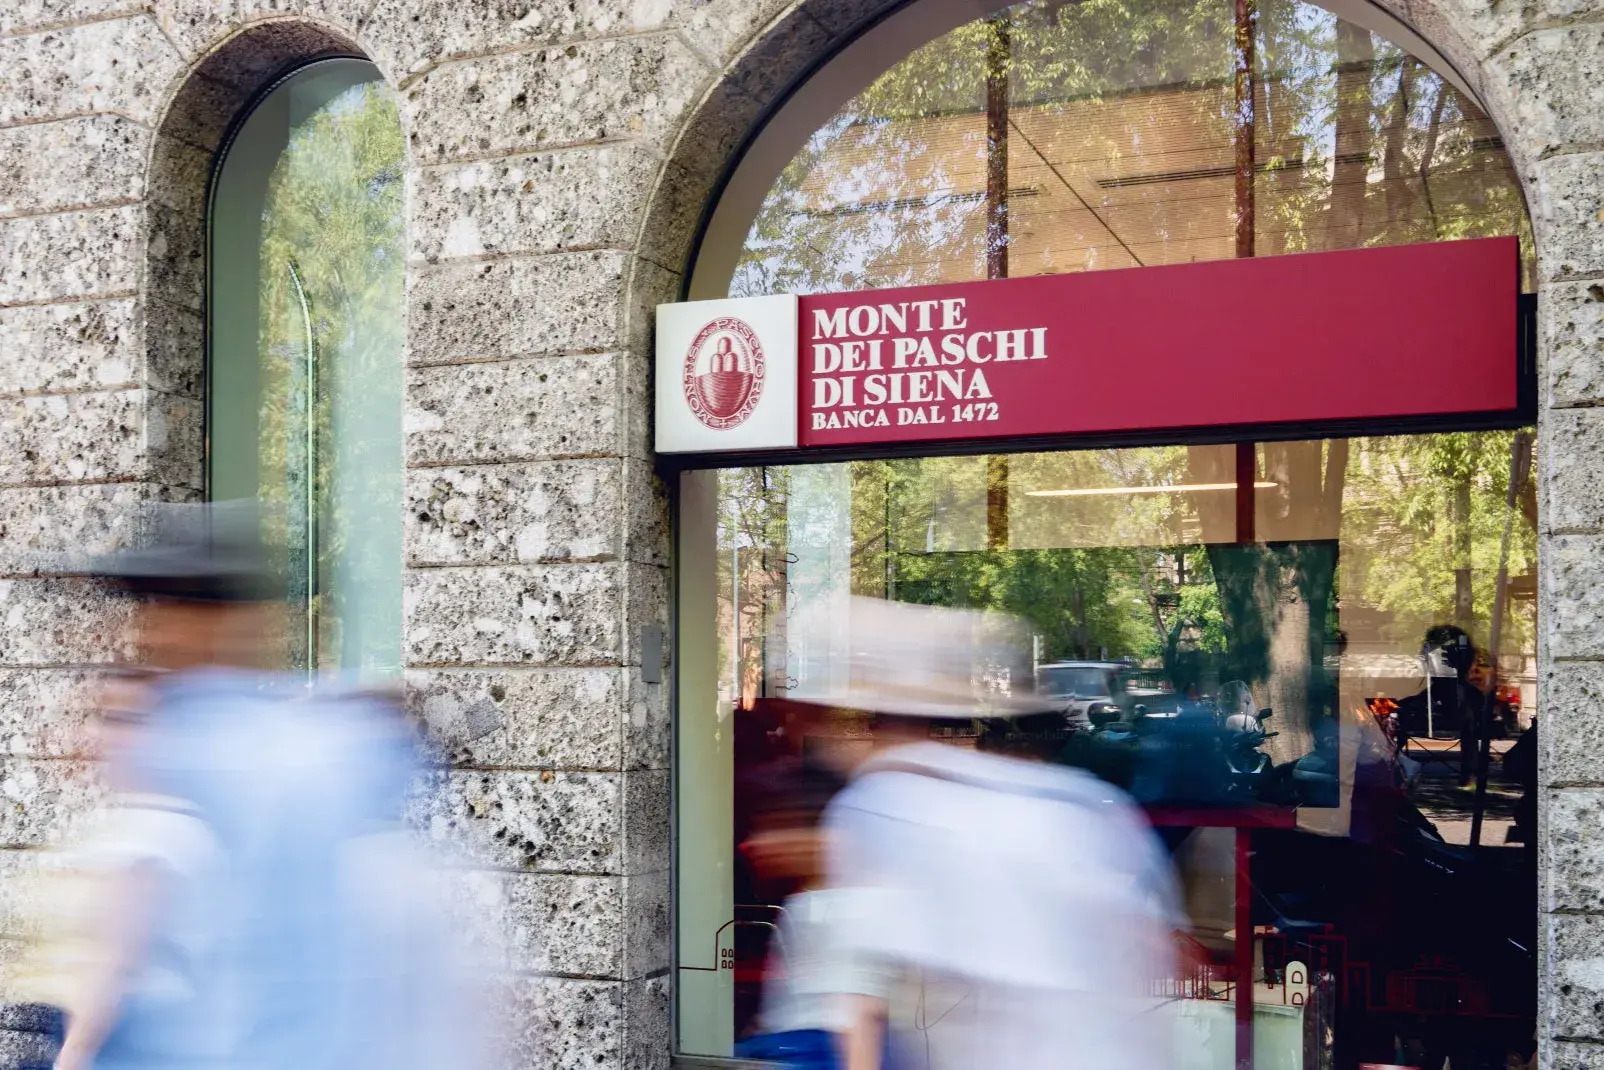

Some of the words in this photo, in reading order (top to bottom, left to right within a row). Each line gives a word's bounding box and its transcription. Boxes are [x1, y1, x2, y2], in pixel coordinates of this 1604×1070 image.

[812, 298, 967, 339] MONTE
[812, 340, 883, 373] DEI
[892, 328, 1048, 368] PASCHI
[812, 376, 856, 408] DI
[864, 368, 992, 405] SIENA
[812, 409, 890, 430] BANCA
[897, 406, 945, 425] DAL
[952, 402, 998, 422] 1472
